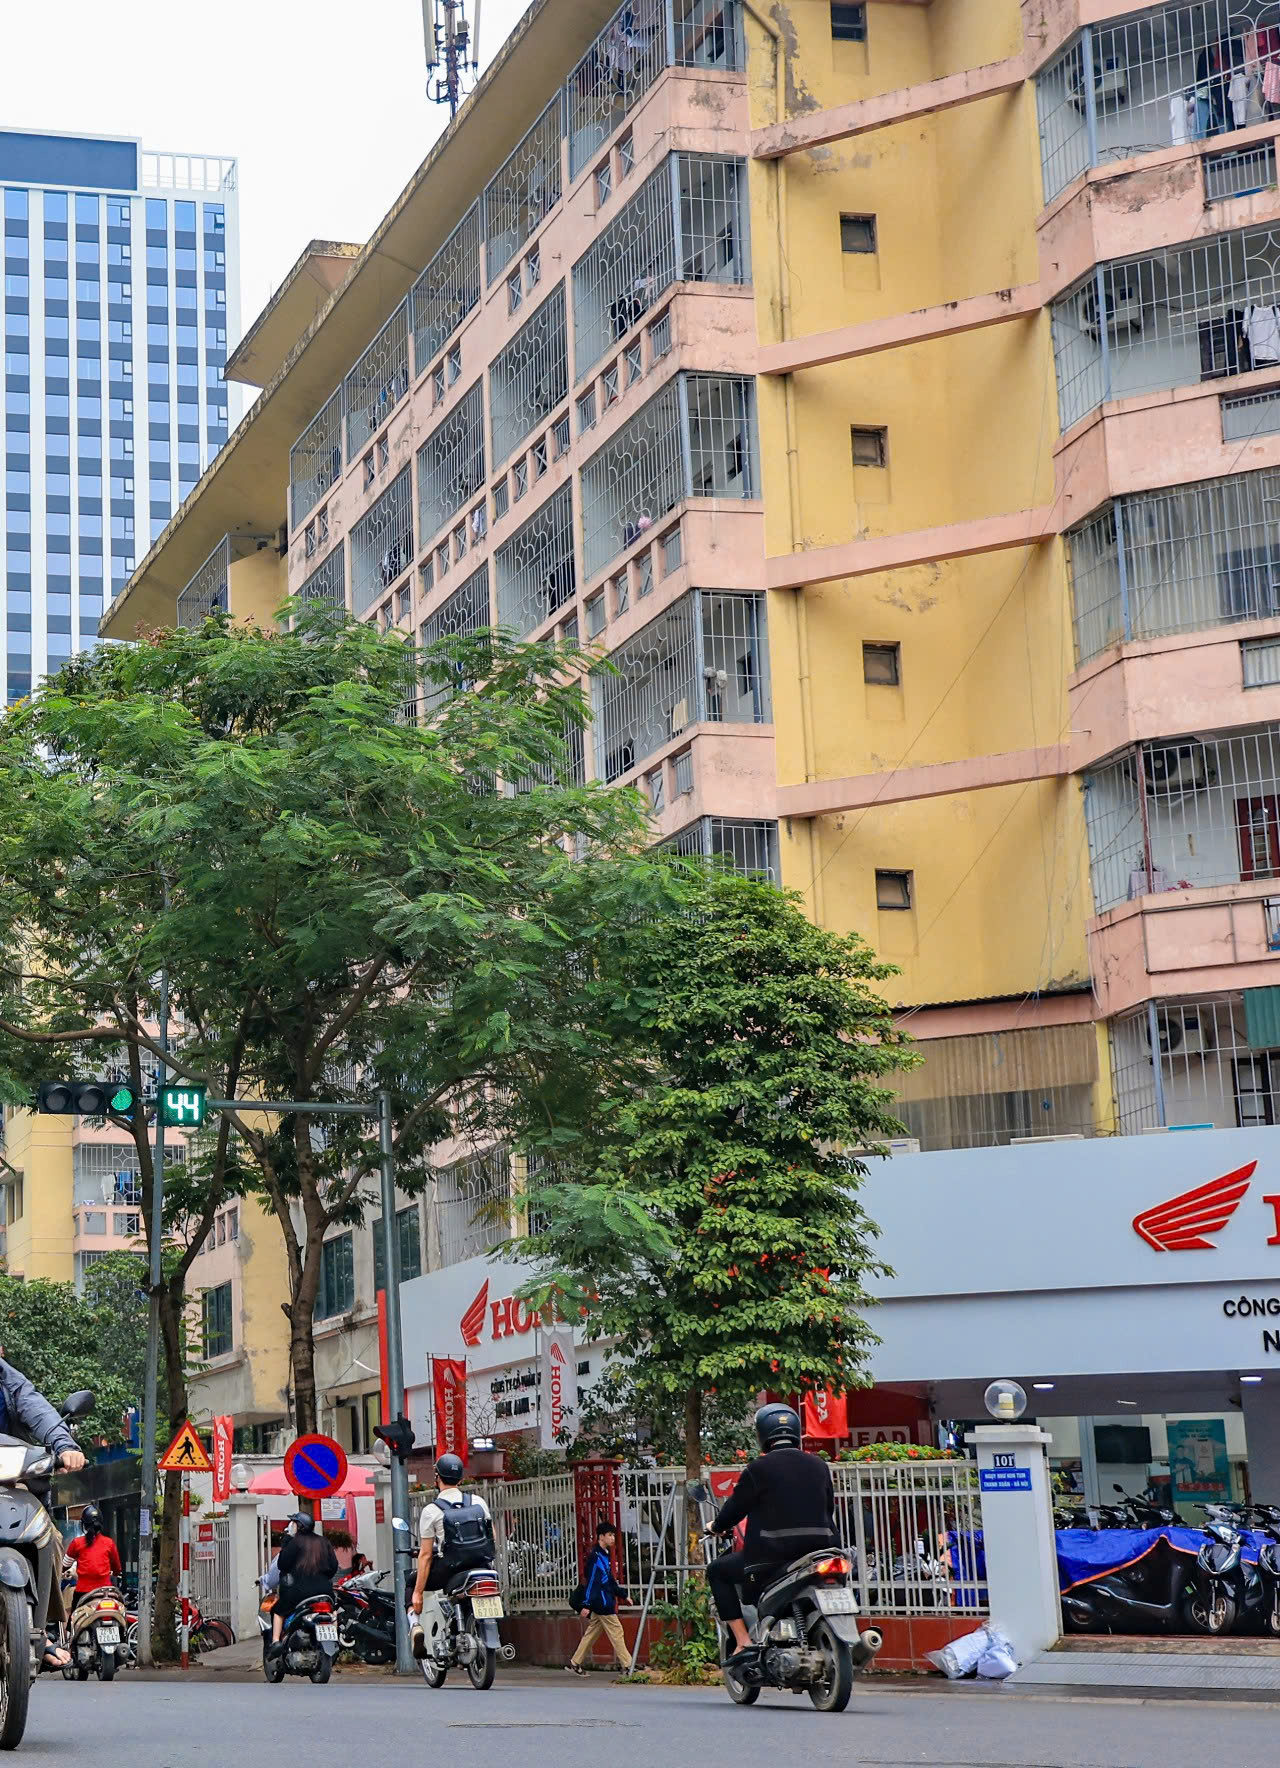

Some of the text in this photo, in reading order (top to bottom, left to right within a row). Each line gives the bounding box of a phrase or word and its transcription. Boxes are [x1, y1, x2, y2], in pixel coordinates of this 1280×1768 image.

[167, 1092, 199, 1121] 44
[1223, 1295, 1280, 1317] CÔNG
[444, 1387, 455, 1453] HONDA
[551, 1365, 563, 1438] HONDA
[217, 1440, 225, 1492] HONDA
